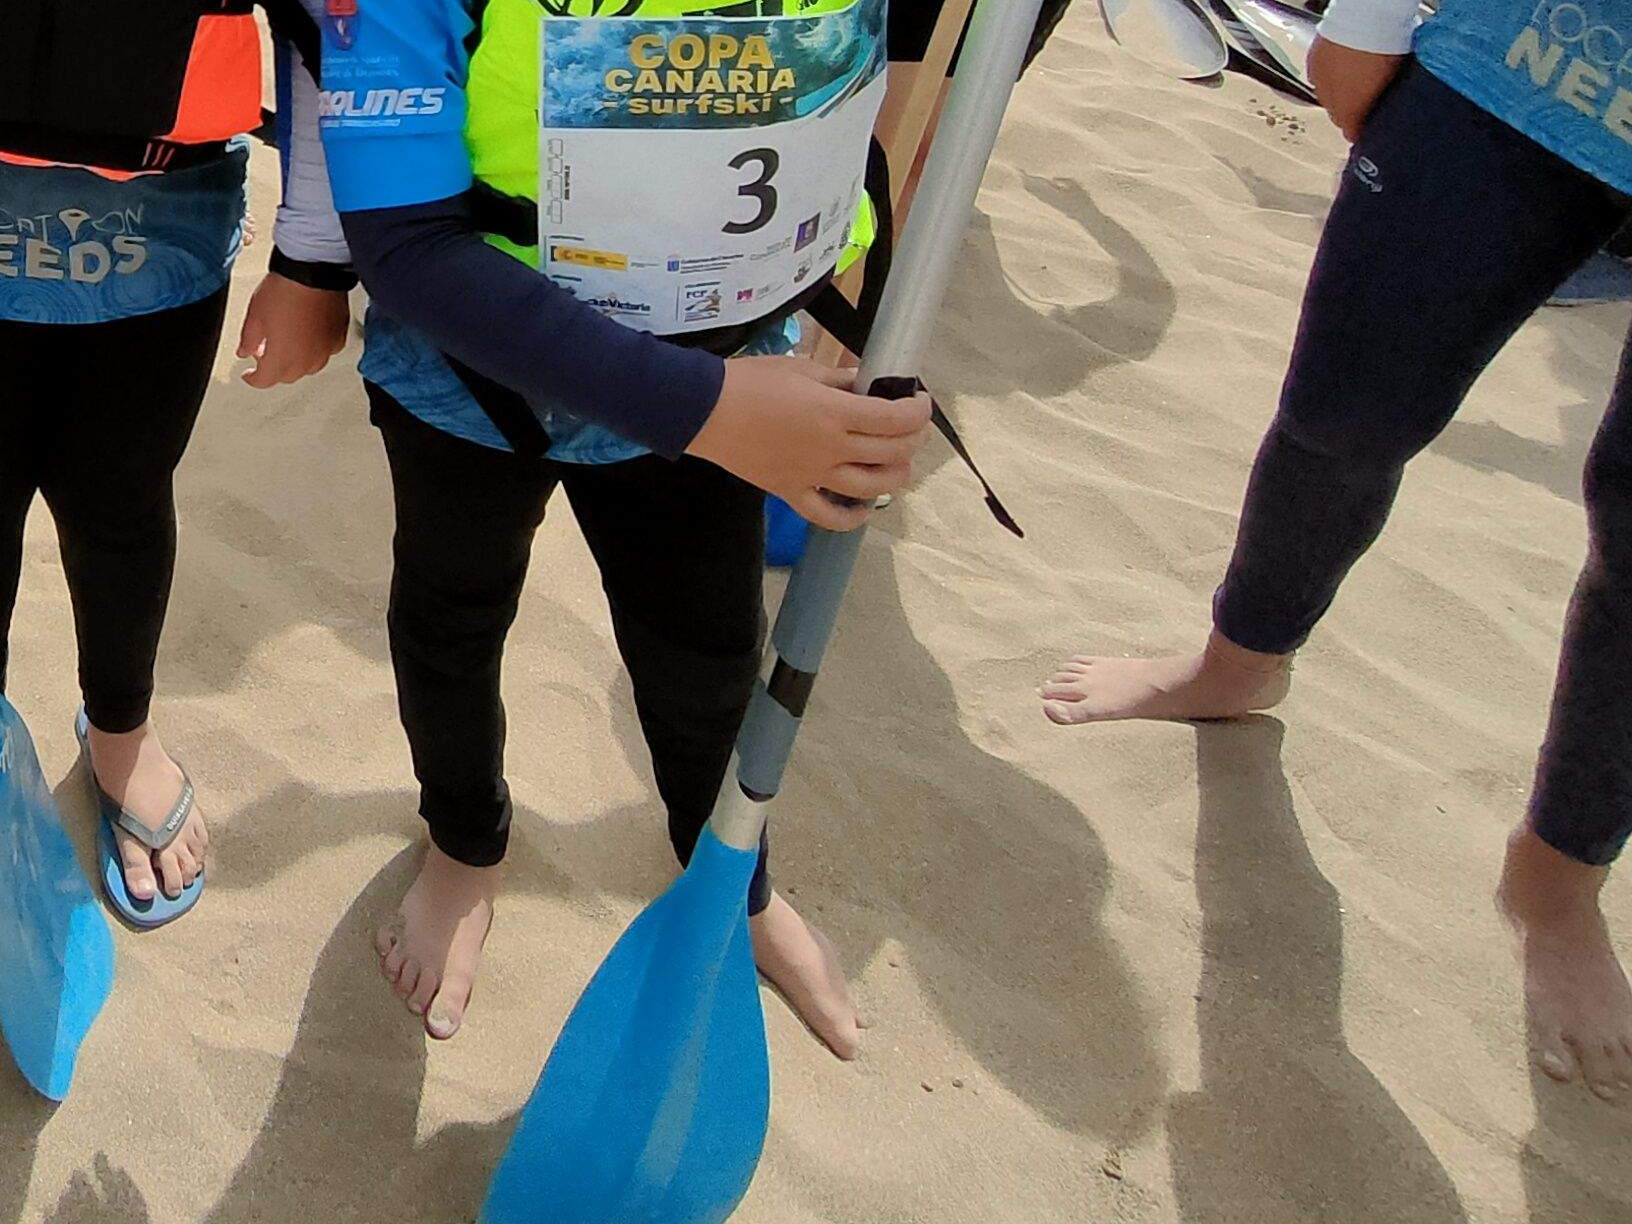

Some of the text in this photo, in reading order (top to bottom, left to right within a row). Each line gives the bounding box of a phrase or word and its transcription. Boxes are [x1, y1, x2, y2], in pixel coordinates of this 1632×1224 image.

[627, 33, 775, 71] COPA
[604, 67, 797, 95] CANARIA
[721, 147, 781, 235] 3
